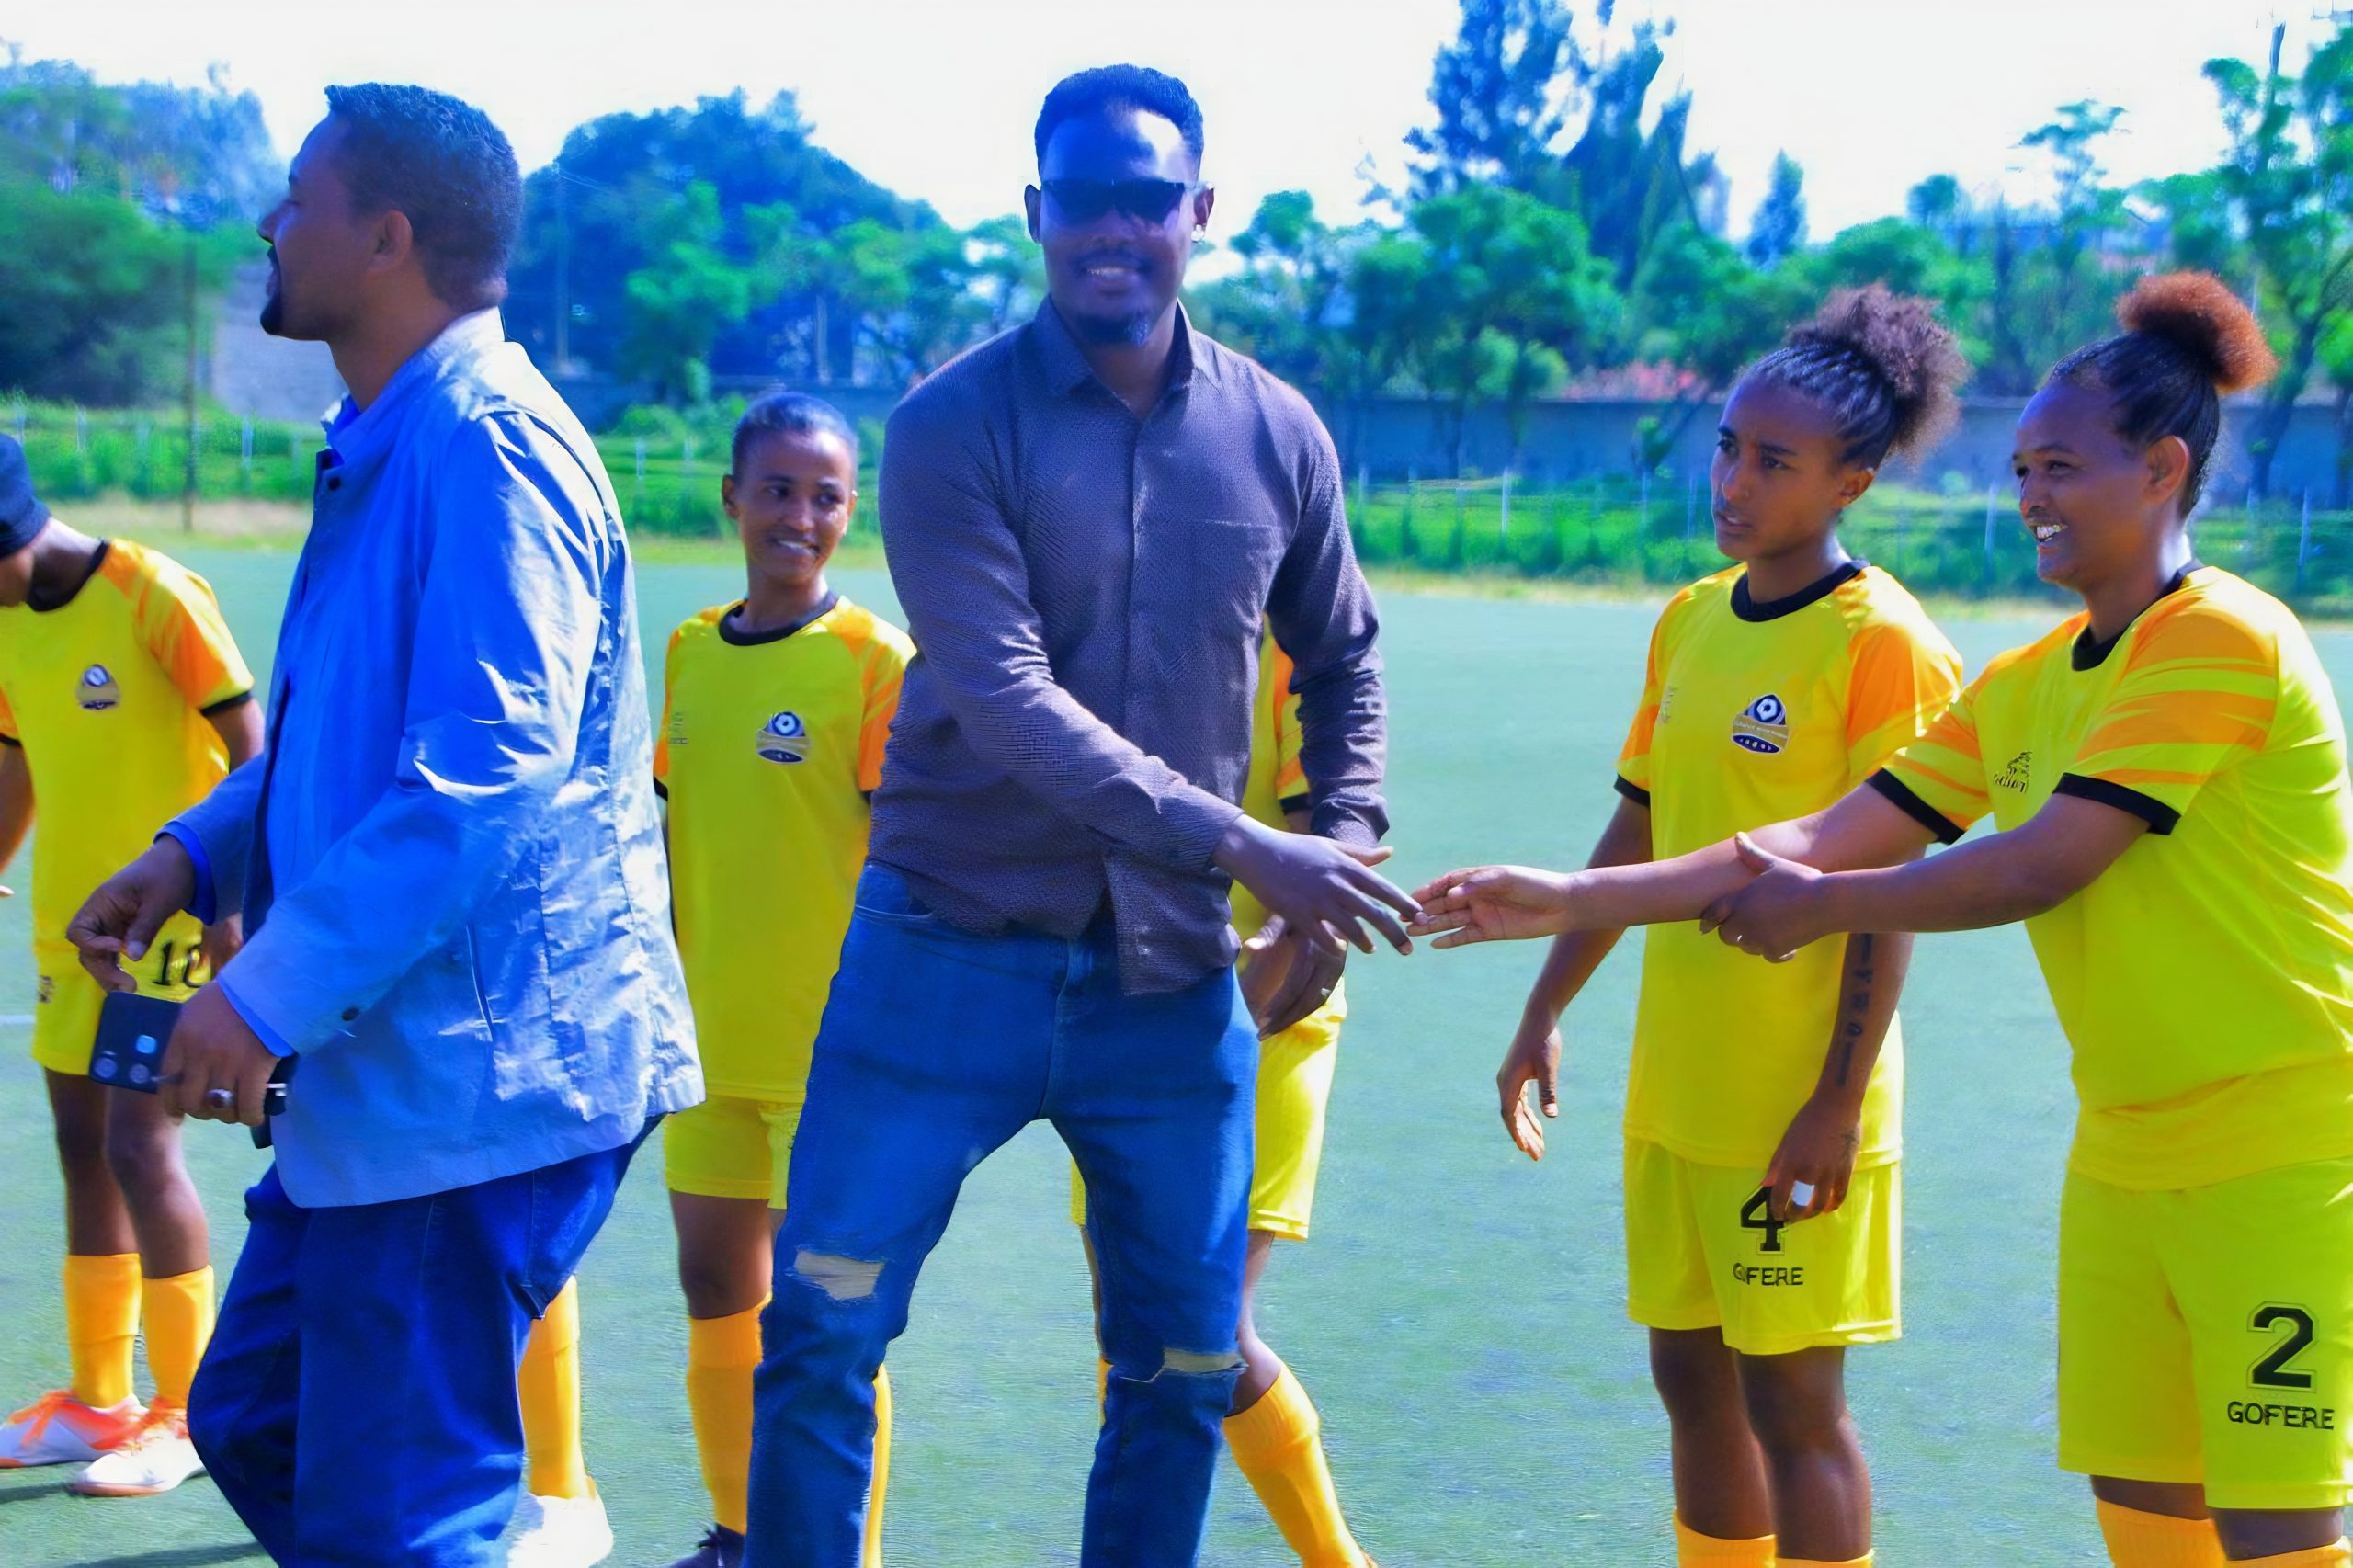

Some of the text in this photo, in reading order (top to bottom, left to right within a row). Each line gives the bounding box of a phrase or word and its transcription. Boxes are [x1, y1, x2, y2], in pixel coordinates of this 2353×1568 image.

[1740, 1184, 1786, 1251] 4
[1733, 1262, 1803, 1286] GFERE
[2252, 1306, 2313, 1389] 2
[2227, 1401, 2336, 1430] GOFERE
